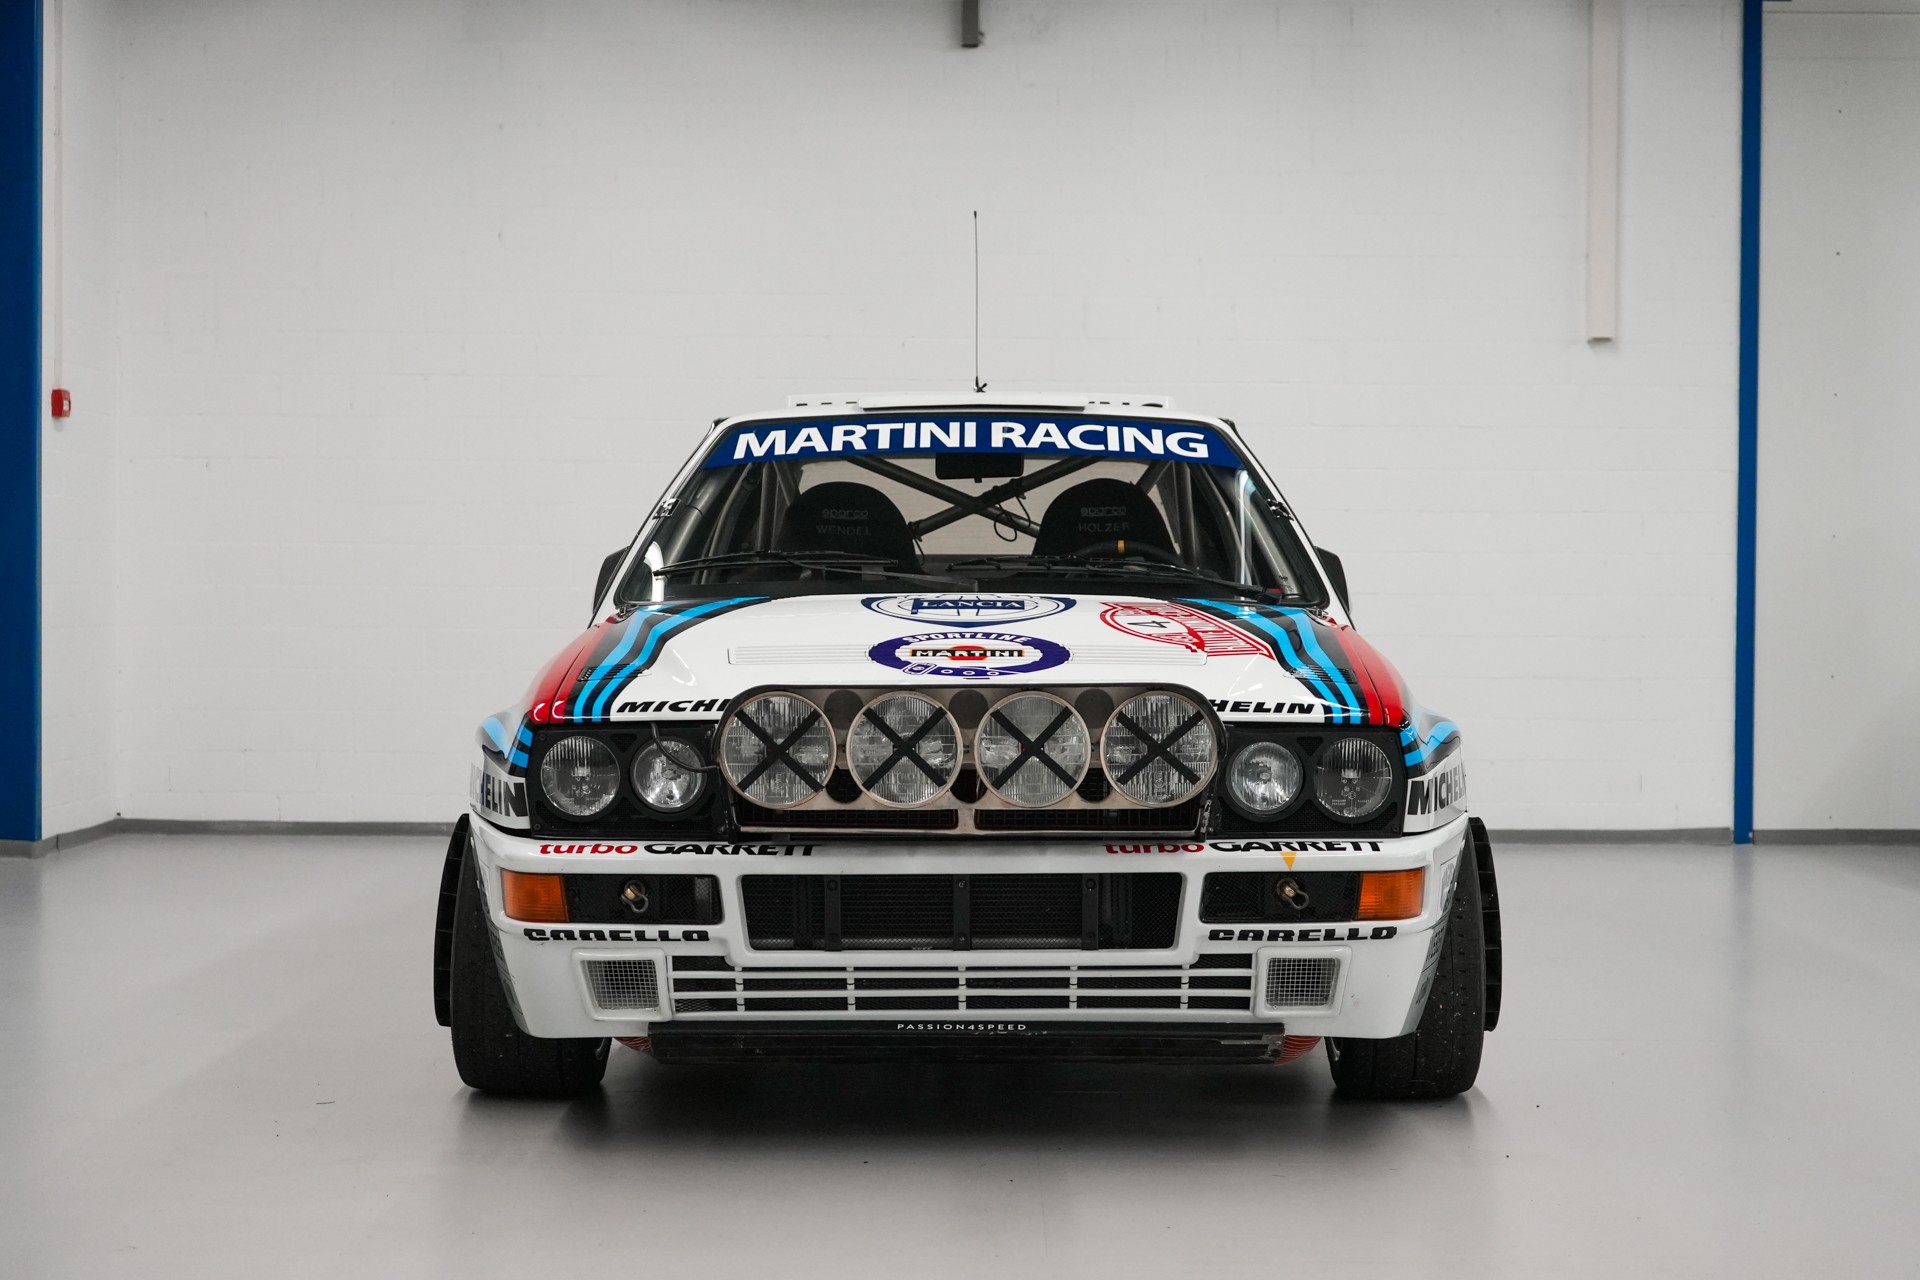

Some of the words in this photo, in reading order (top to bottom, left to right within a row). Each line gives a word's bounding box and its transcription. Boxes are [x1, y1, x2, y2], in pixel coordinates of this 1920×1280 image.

[733, 421, 977, 460] MARTINI
[991, 421, 1209, 458] RACING
[816, 524, 872, 535] WENDEL
[1078, 522, 1129, 533] HOLZER
[1127, 619, 1171, 629] 4
[903, 632, 1033, 643] SPORTLINE
[540, 843, 638, 855] turbo
[644, 843, 821, 856] GARRETT
[1103, 842, 1205, 854] turbo
[1208, 841, 1383, 853] GARRETT
[523, 928, 710, 941] CARELLO
[1208, 926, 1397, 941] CARELLO
